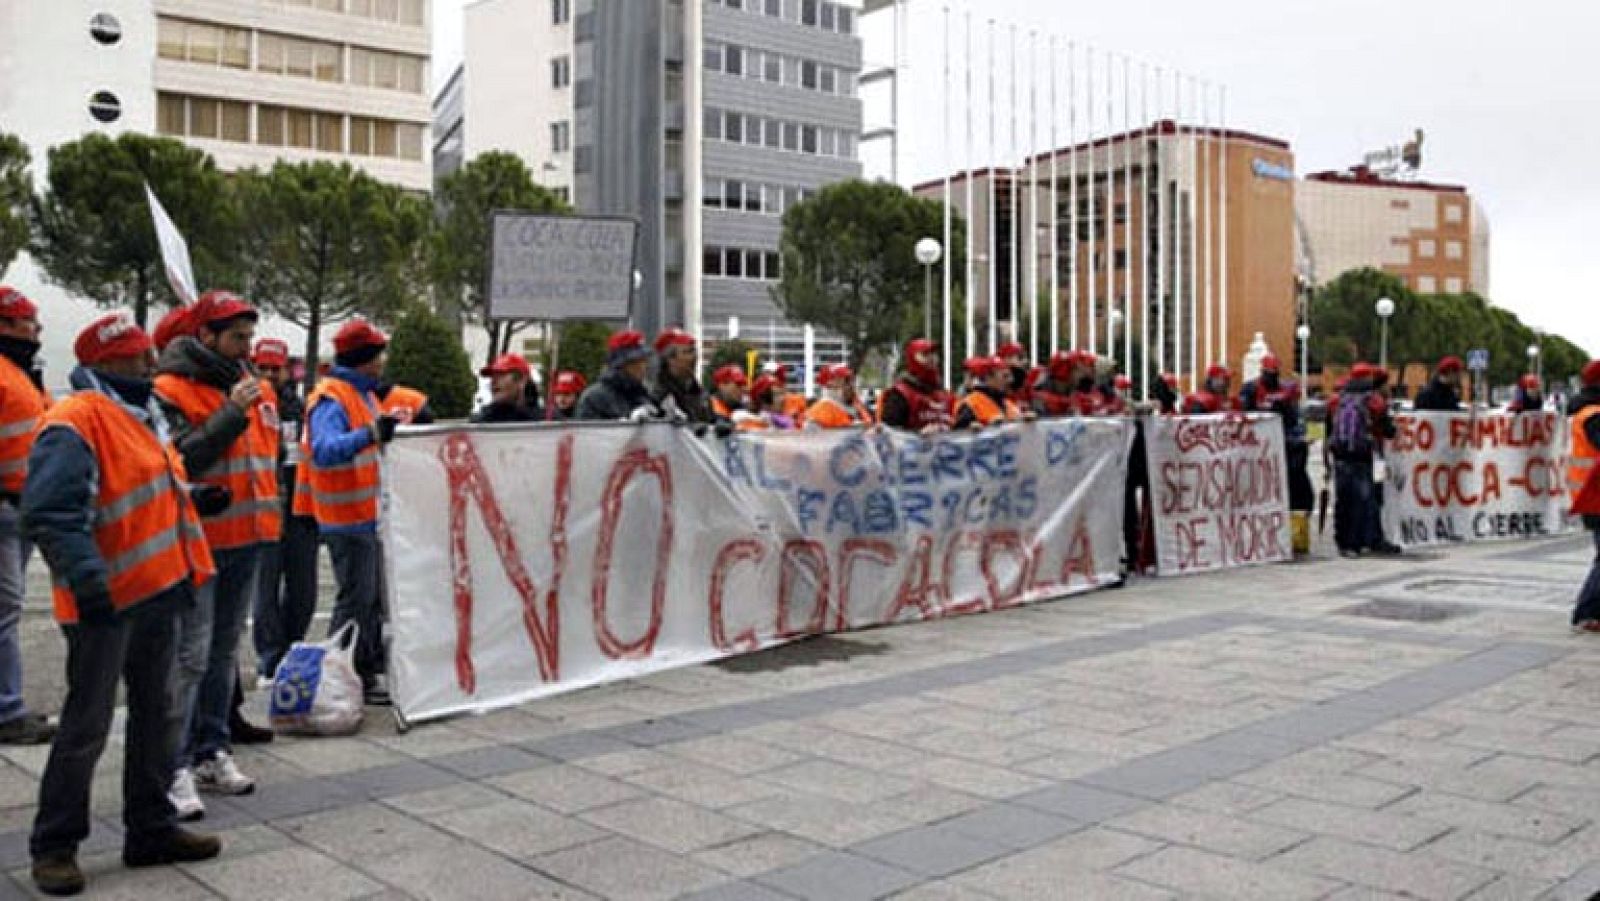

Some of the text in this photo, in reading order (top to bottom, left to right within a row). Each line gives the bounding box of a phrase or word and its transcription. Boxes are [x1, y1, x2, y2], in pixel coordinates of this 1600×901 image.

[724, 420, 1086, 491] AL CIERRE DE
[439, 432, 674, 695] NO
[1176, 516, 1211, 571] DE
[1401, 517, 1428, 544] NO
[1435, 515, 1463, 541] AL
[708, 516, 1097, 651] COCACOLA
